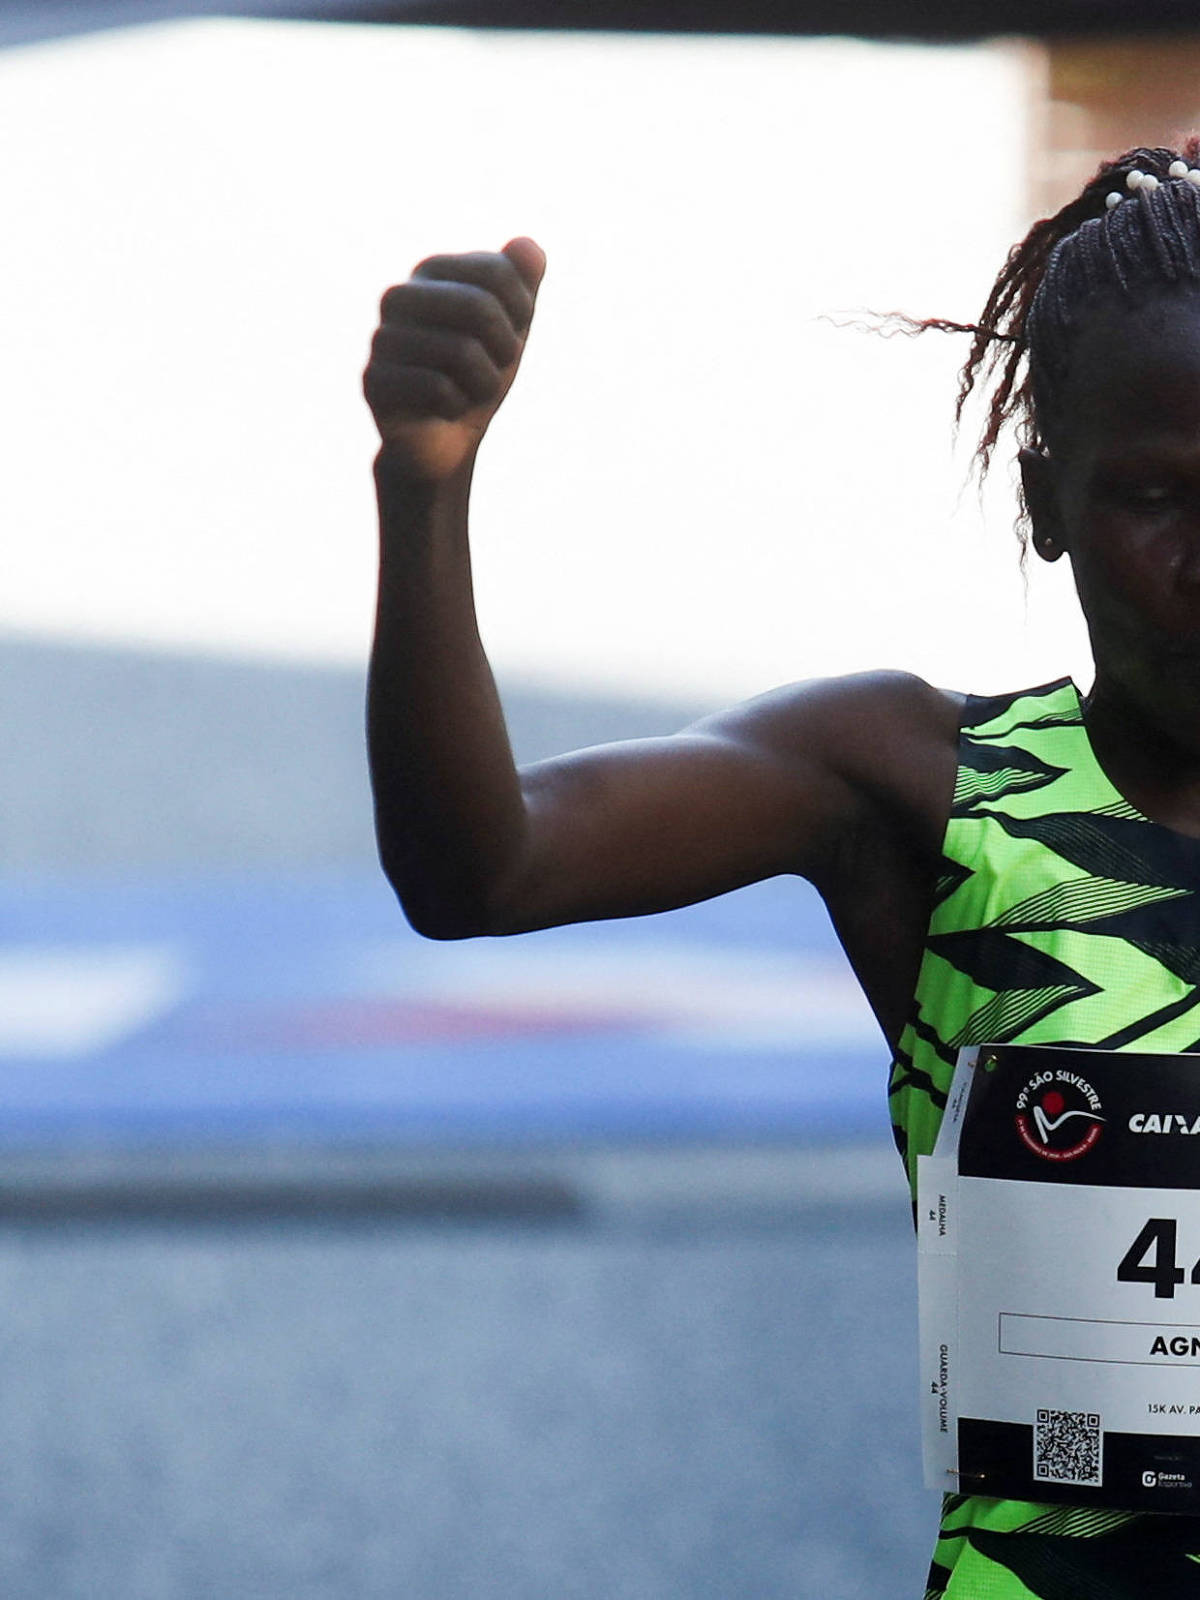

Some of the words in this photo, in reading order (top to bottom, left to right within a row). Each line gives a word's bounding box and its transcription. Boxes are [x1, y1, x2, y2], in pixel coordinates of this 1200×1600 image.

[1029, 1071, 1053, 1090] SÃO
[1055, 1070, 1102, 1110] SILVESTRE
[1148, 1404, 1166, 1414] 15K
[1169, 1404, 1187, 1415] AV.
[1158, 1472, 1186, 1481] Gazeta
